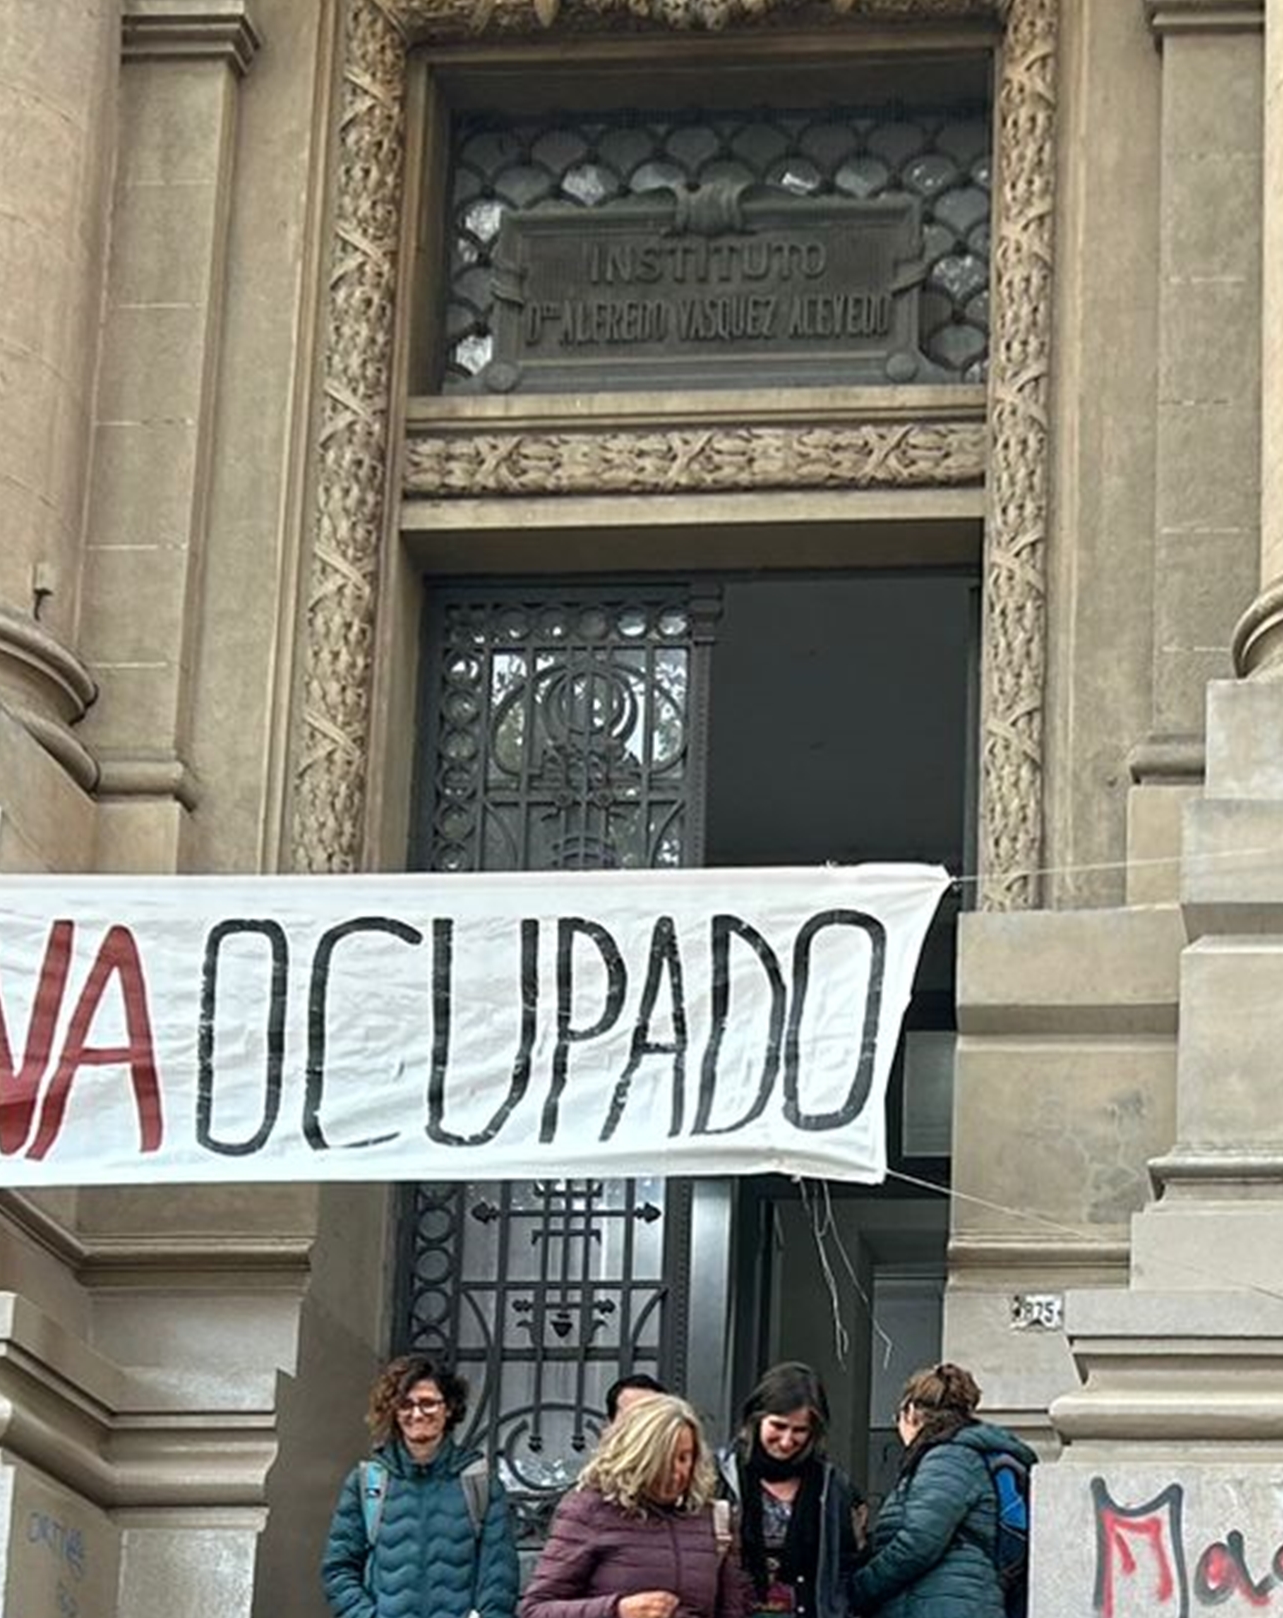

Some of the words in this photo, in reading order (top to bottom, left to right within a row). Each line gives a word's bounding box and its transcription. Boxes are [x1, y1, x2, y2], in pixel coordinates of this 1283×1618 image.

[586, 241, 827, 286] INSTITUTO
[560, 298, 668, 346] ALFREDO
[677, 295, 779, 342] VASQUEZ
[788, 291, 891, 341] ACEVEDO
[194, 908, 888, 1158] OCUPADO
